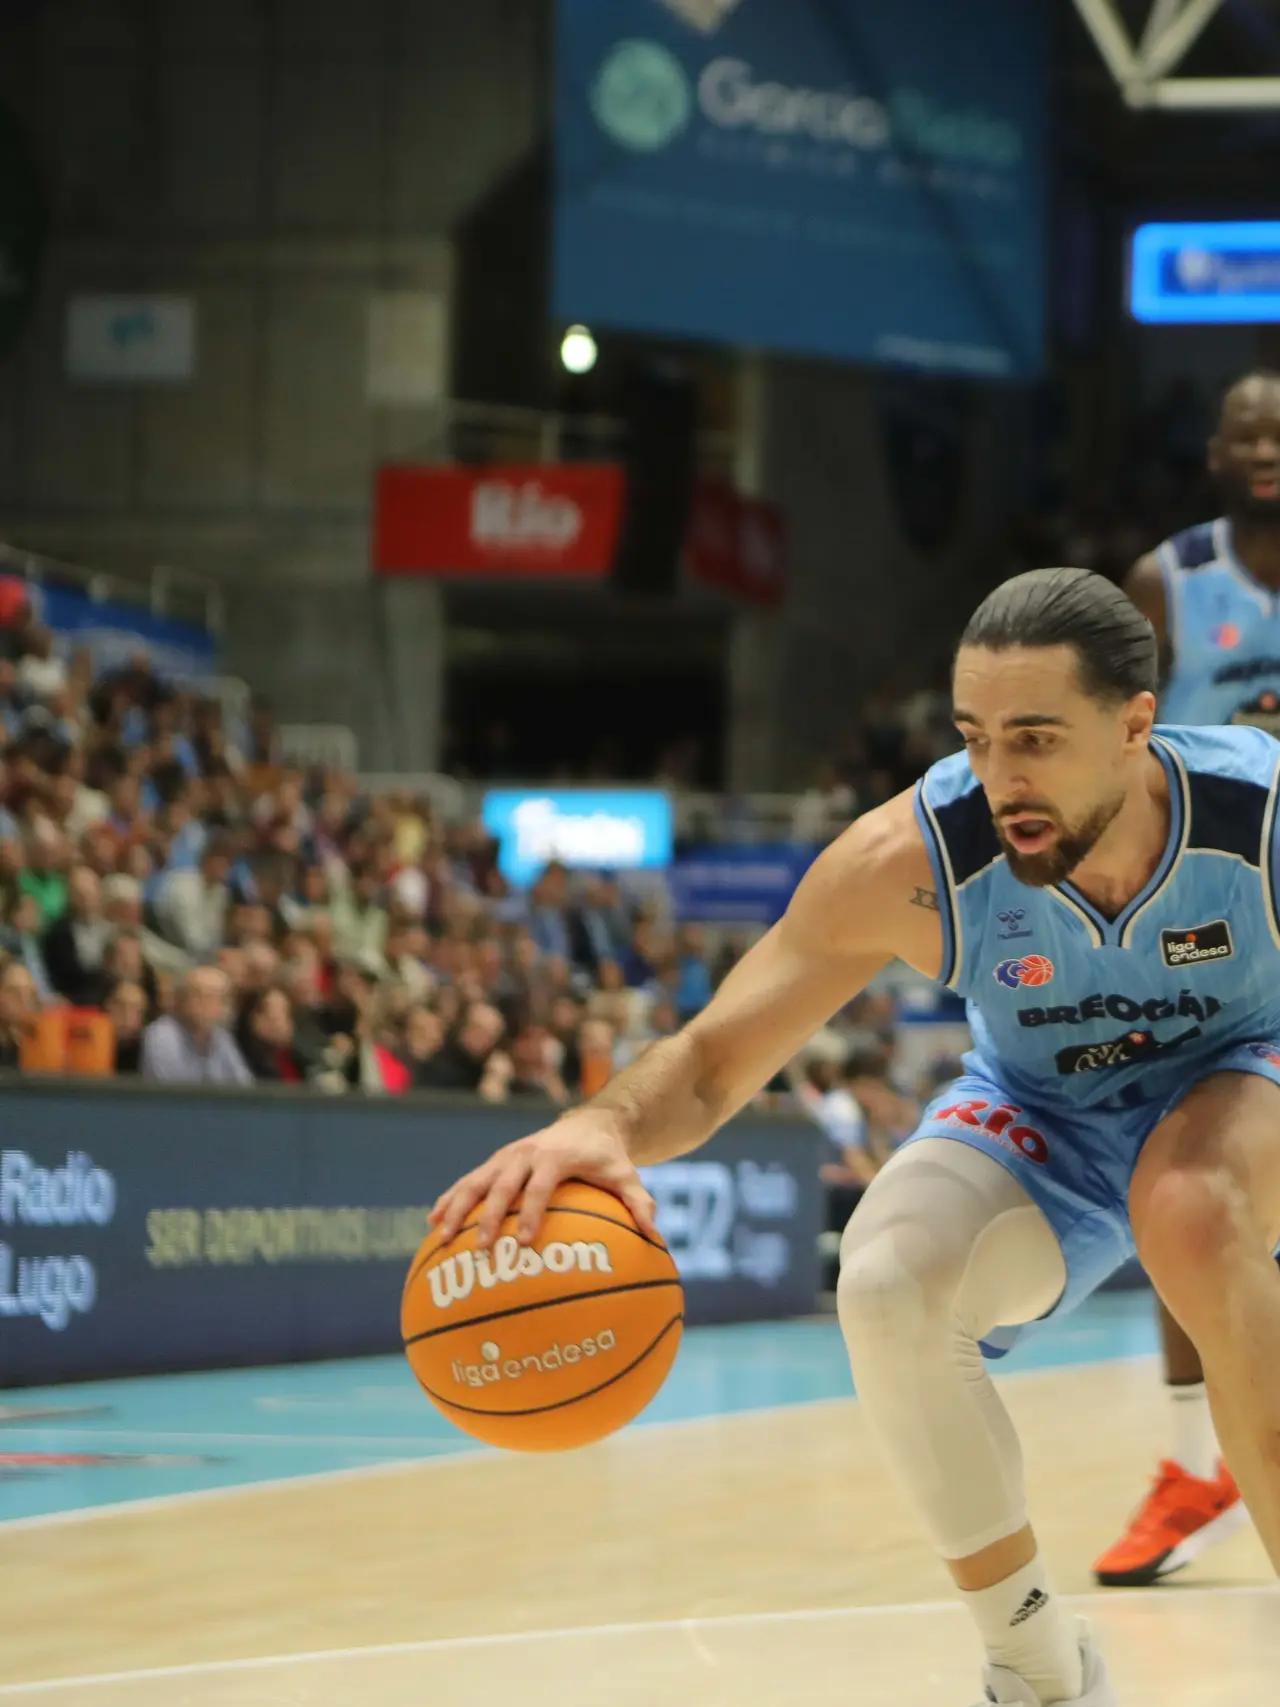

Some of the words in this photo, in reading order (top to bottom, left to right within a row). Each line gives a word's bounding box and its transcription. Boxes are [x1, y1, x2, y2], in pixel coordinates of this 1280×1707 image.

[1167, 942, 1196, 953] liga
[1170, 945, 1229, 963] endesa
[0, 1149, 117, 1226] Radio
[427, 1235, 614, 1309] Wilson
[452, 1359, 501, 1387] liga
[502, 1327, 617, 1379] endesa
